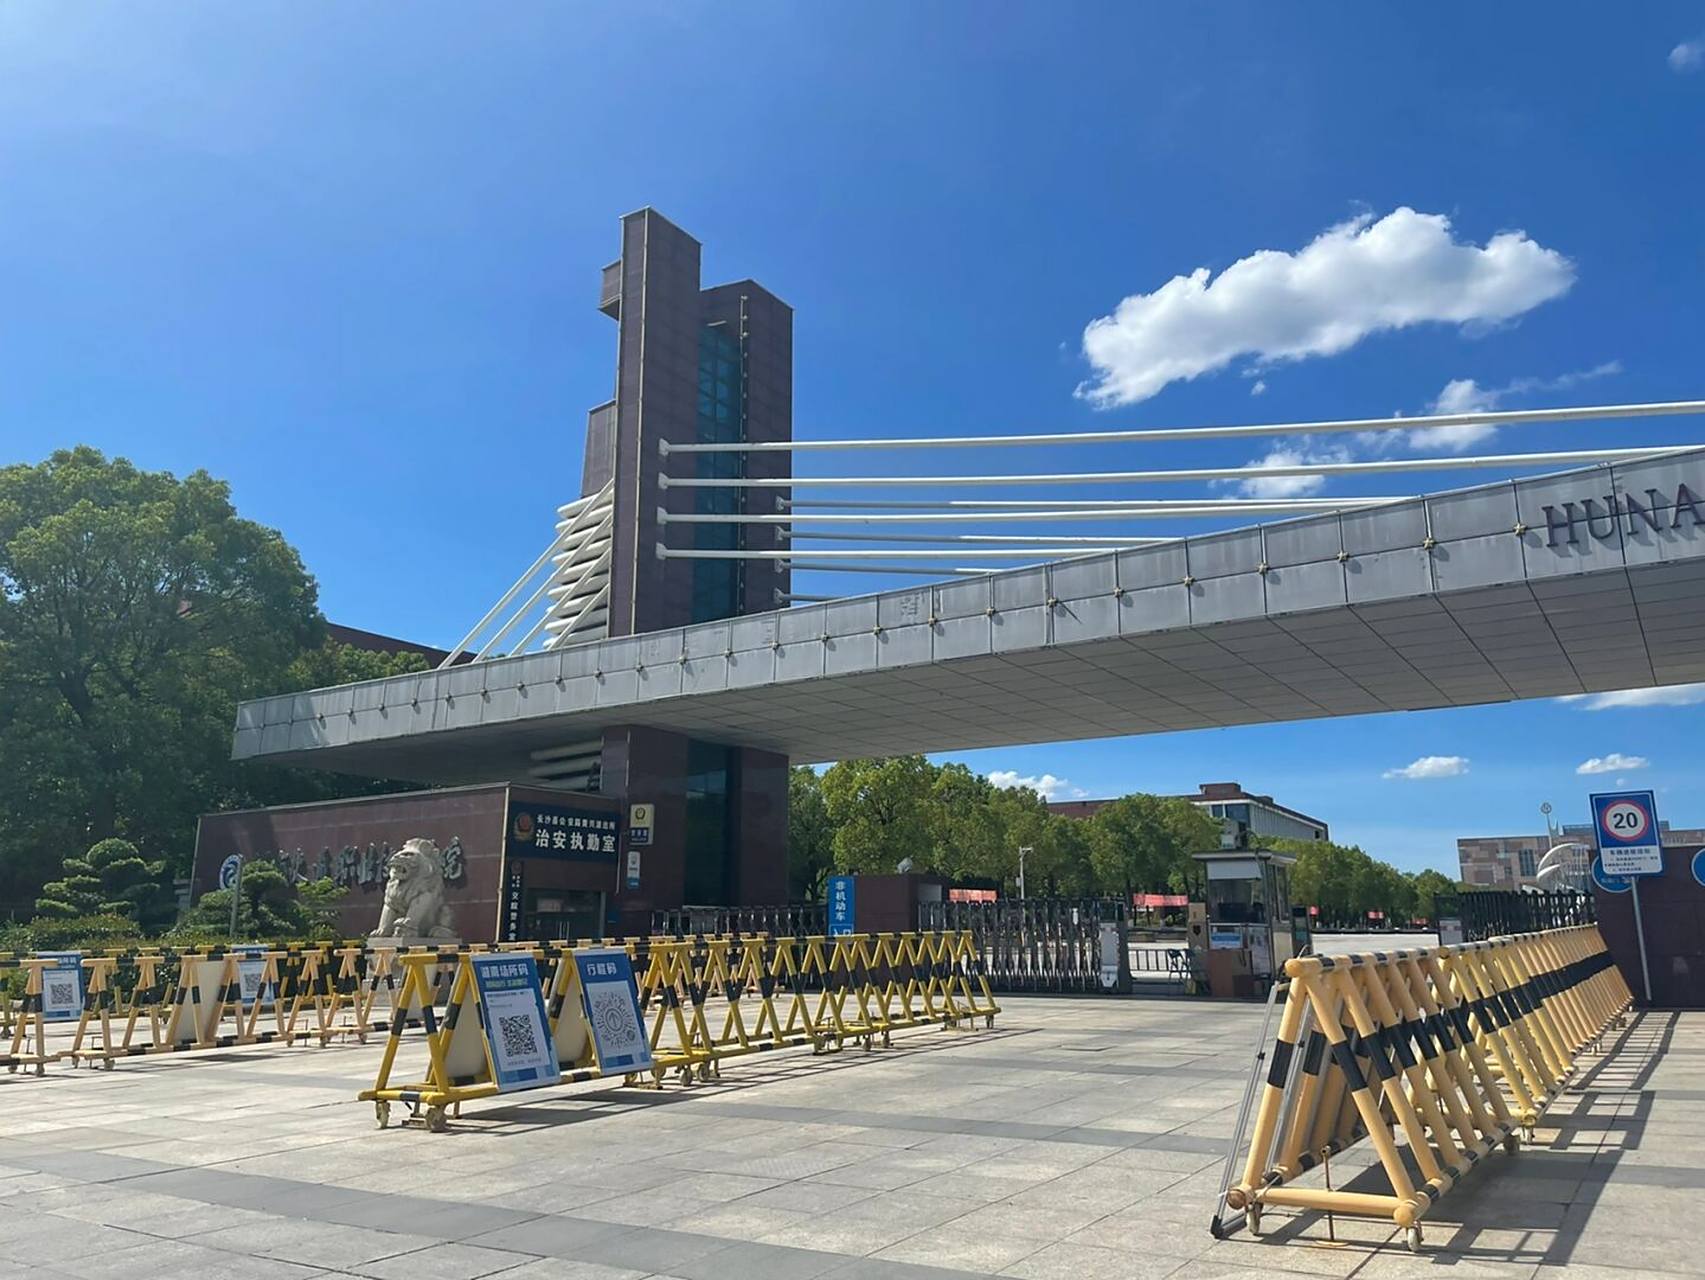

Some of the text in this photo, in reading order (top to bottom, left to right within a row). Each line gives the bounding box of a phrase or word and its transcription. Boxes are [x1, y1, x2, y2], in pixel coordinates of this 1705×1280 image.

[1541, 483, 1705, 547] HUNA
[1613, 812, 1638, 829] 20
[535, 829, 616, 852] 治安执勤室
[587, 962, 617, 976] 行程码
